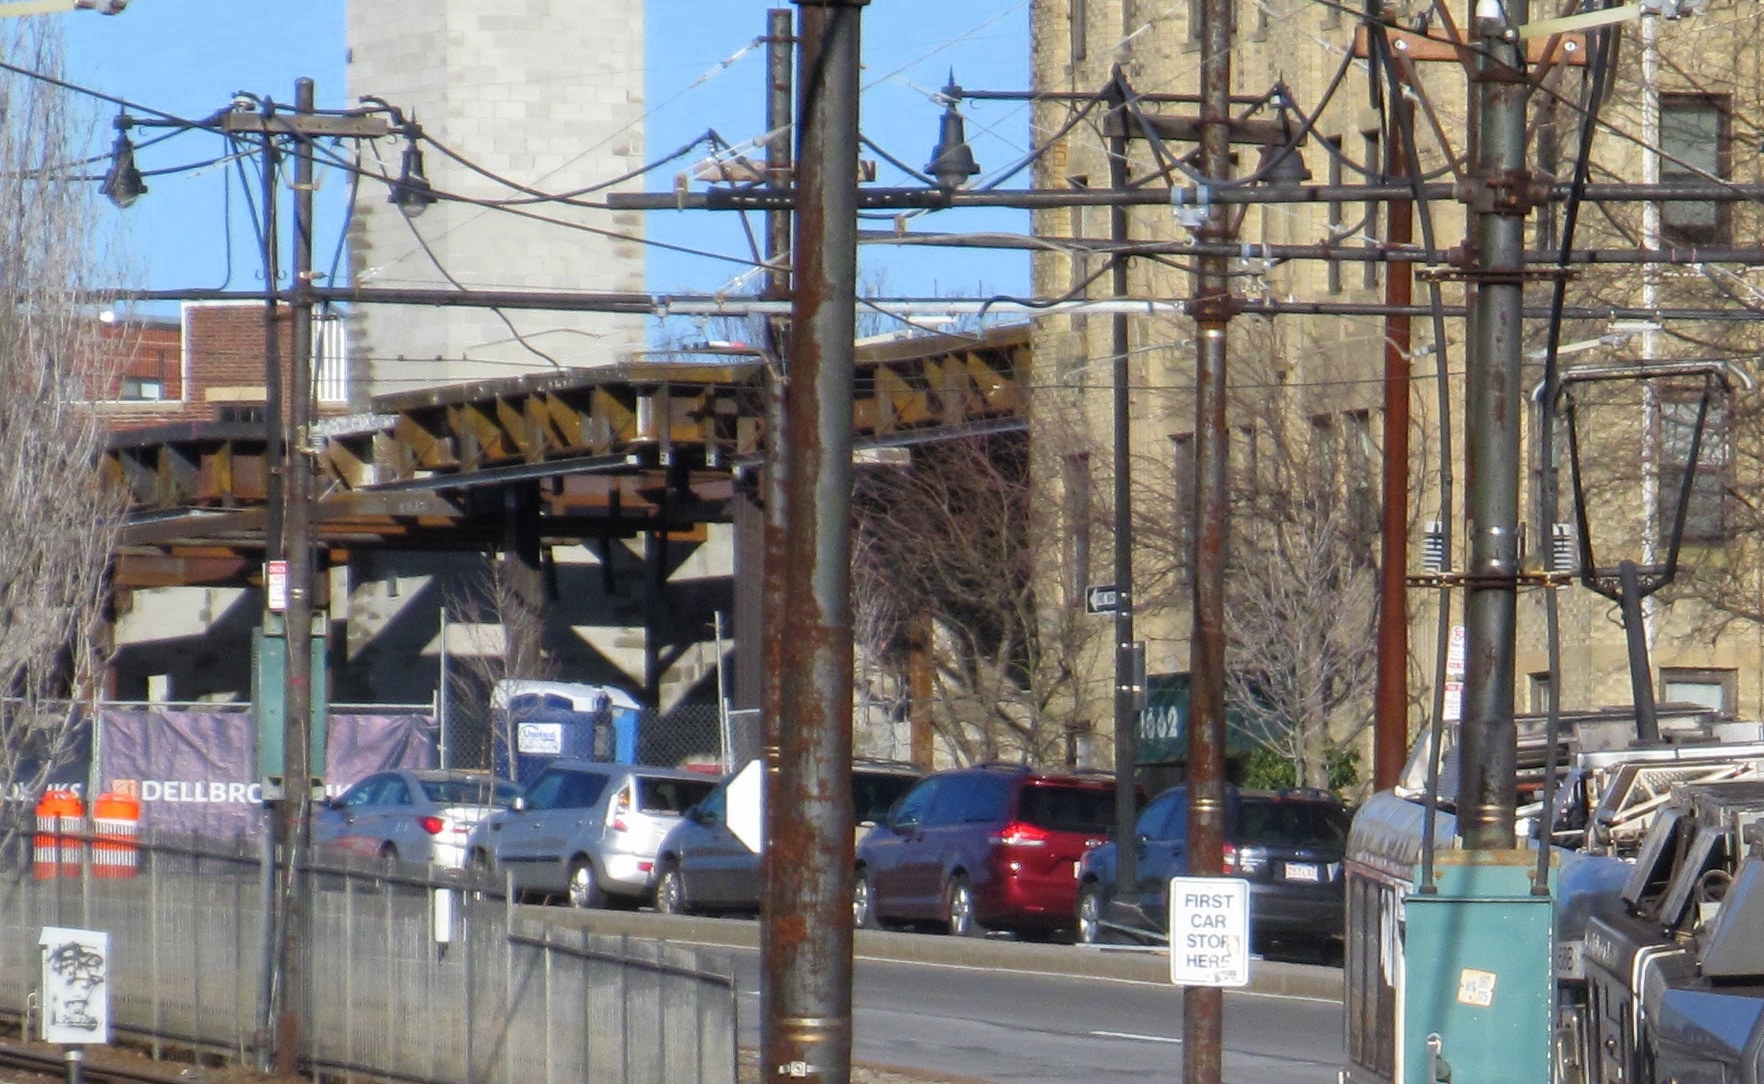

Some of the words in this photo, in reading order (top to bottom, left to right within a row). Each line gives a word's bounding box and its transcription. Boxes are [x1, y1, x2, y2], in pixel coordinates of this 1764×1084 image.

[141, 779, 262, 804] DELLBRO
[1184, 893, 1234, 909] FIRST
[1190, 913, 1226, 928] CAR
[1186, 953, 1231, 969] HERE
